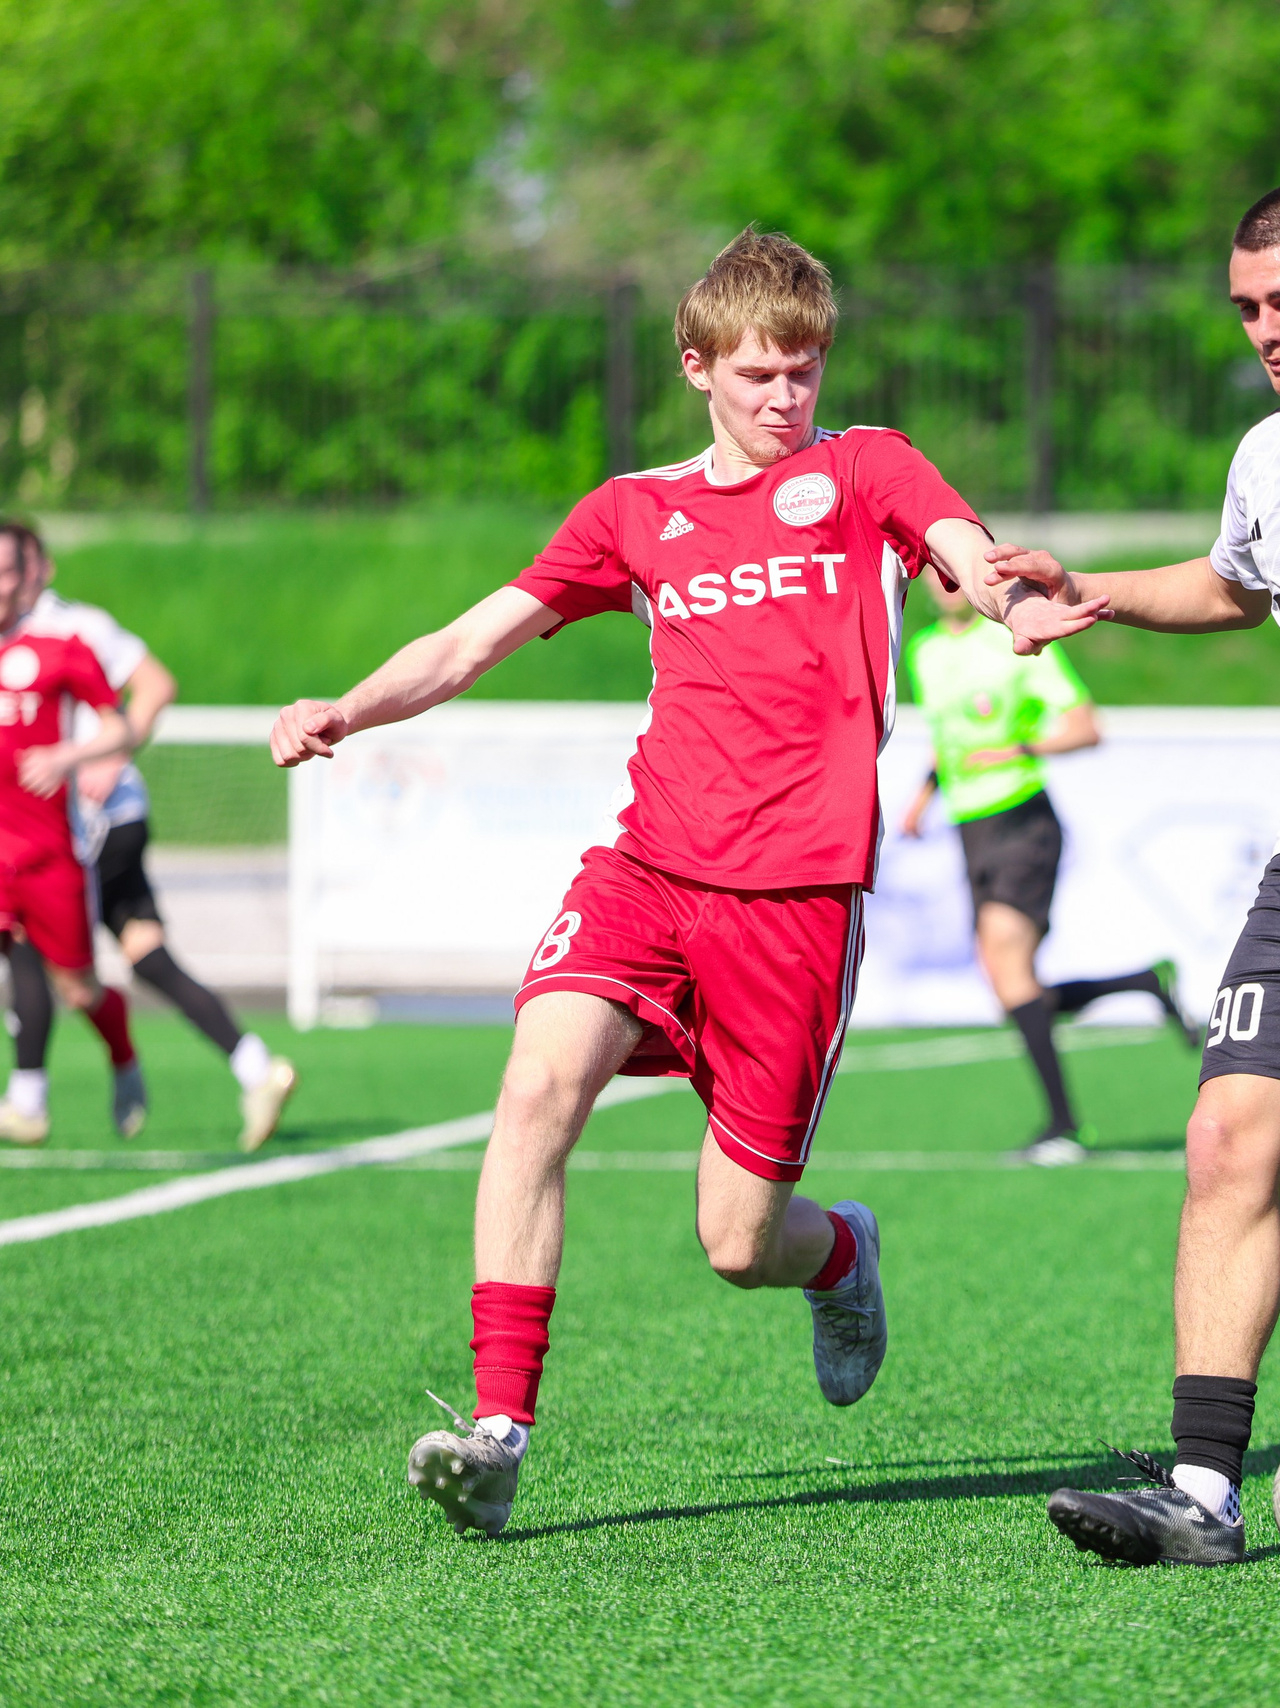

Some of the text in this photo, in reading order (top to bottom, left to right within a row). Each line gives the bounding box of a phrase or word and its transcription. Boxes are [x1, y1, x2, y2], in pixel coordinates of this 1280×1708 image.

[659, 522, 695, 541] adidas
[778, 496, 830, 511] ОЛИМП
[657, 553, 847, 621] ASSET
[531, 910, 582, 971] 8
[1206, 982, 1265, 1049] 90
